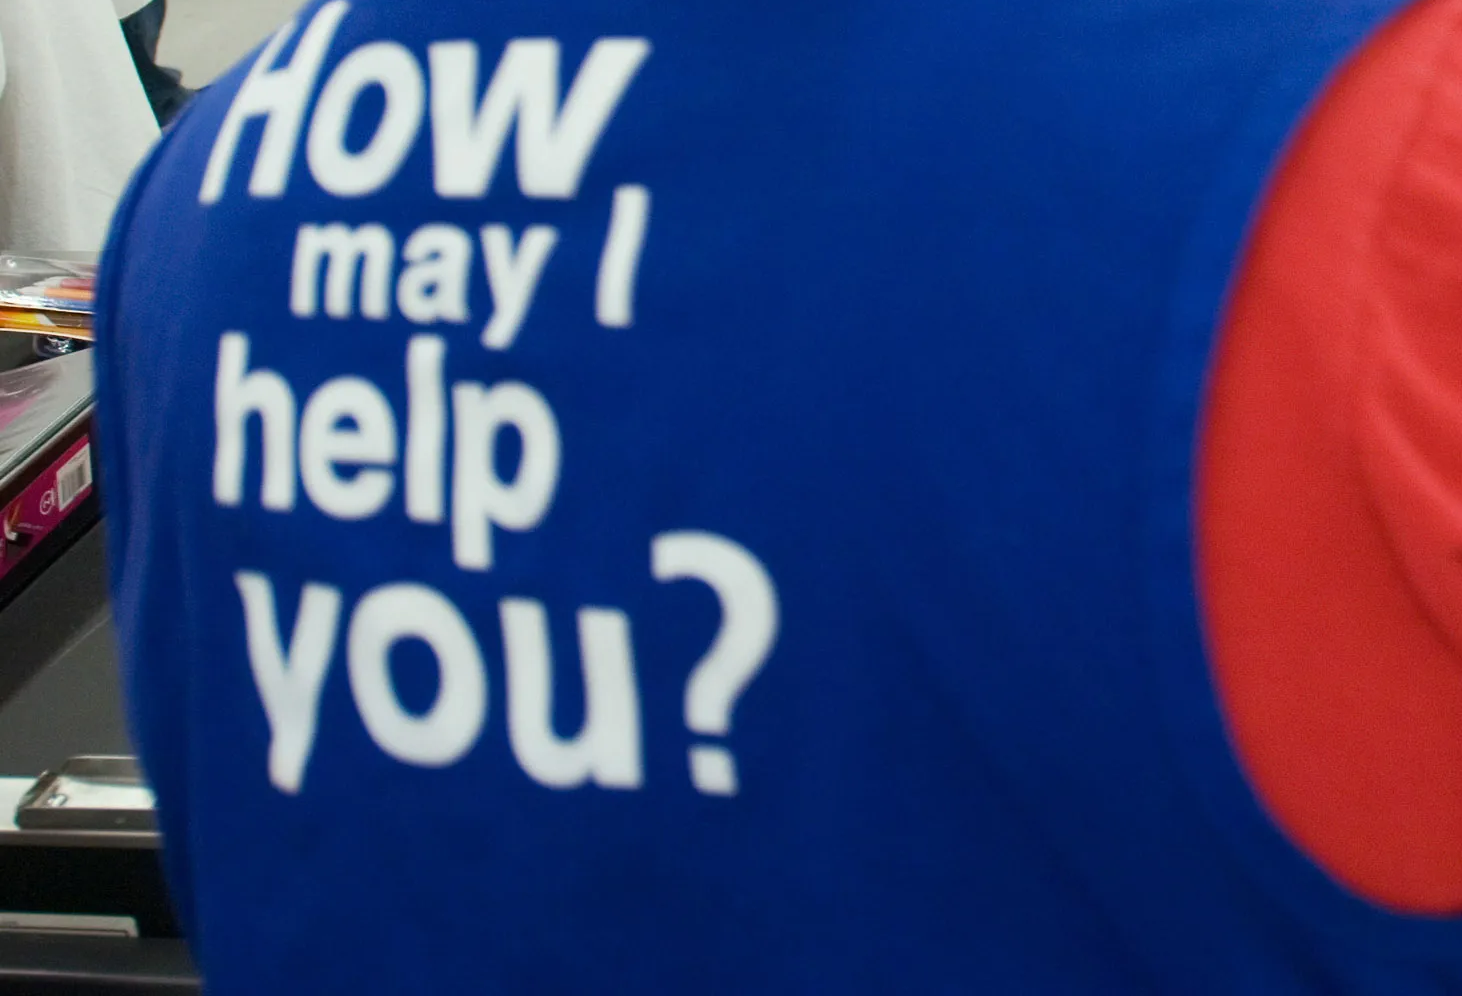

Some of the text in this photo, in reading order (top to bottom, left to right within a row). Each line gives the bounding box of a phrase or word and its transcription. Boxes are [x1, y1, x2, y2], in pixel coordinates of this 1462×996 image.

[291, 184, 650, 351] may I
[213, 330, 562, 572] help
[236, 529, 780, 796] you?
